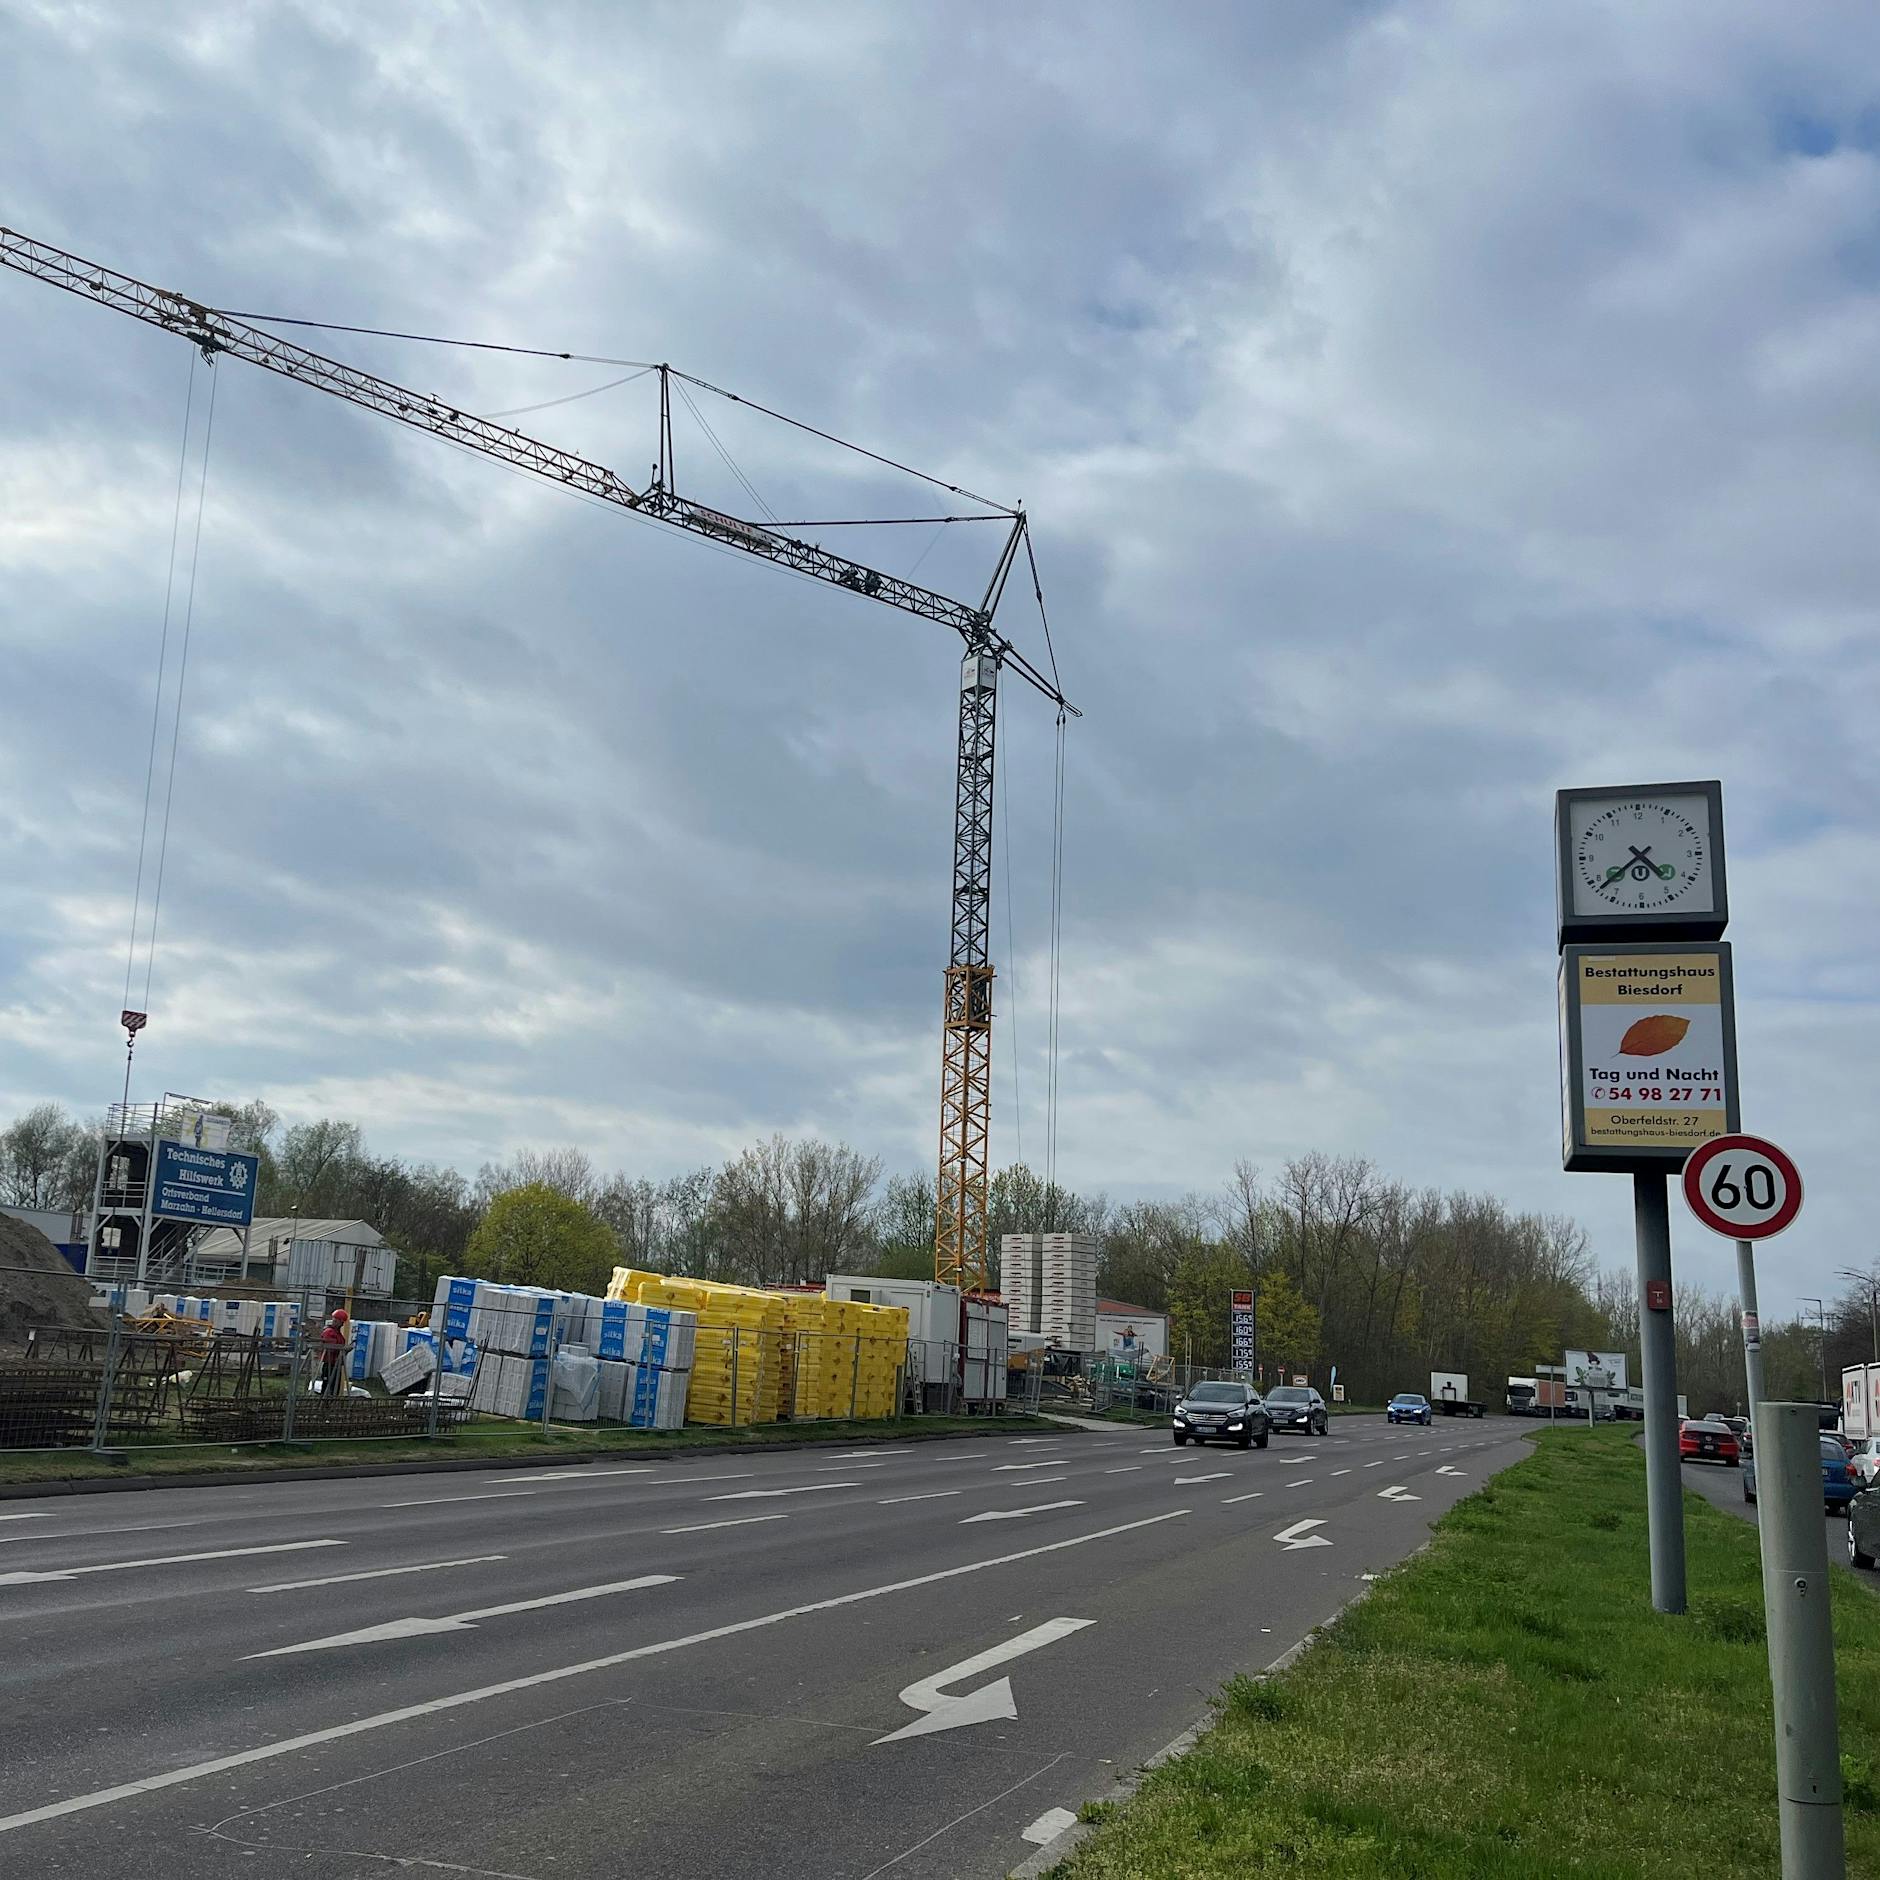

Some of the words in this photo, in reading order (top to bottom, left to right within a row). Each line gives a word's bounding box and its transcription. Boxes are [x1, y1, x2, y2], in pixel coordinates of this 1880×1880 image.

[1633, 812, 1643, 820] 12
[1678, 830, 1684, 838] 2
[1588, 854, 1594, 862] 9
[1686, 850, 1692, 858] 3
[1585, 966, 1715, 980] Bestattungshaus
[1617, 984, 1683, 996] Biesdorf
[1589, 1068, 1620, 1082] Tag
[1626, 1068, 1660, 1080] und
[1666, 1068, 1719, 1081] Nacht
[1608, 1087, 1633, 1101] 54
[1638, 1087, 1663, 1101] 98
[1669, 1088, 1694, 1101] 27
[1700, 1088, 1722, 1101] 71
[1610, 1115, 1680, 1126] Oberfeldstr.
[1683, 1116, 1699, 1126] 27
[1591, 1127, 1721, 1138] bestattungshaus-biesdorf.de
[166, 1147, 226, 1169] Technisches
[178, 1168, 224, 1187] Hilfswerk
[1711, 1164, 1776, 1210] 60
[161, 1186, 210, 1203] Ortsverband
[160, 1199, 196, 1213] Marzahn
[201, 1205, 244, 1220] Hellersdorf
[452, 1286, 472, 1296] silka
[603, 1330, 622, 1340] silka
